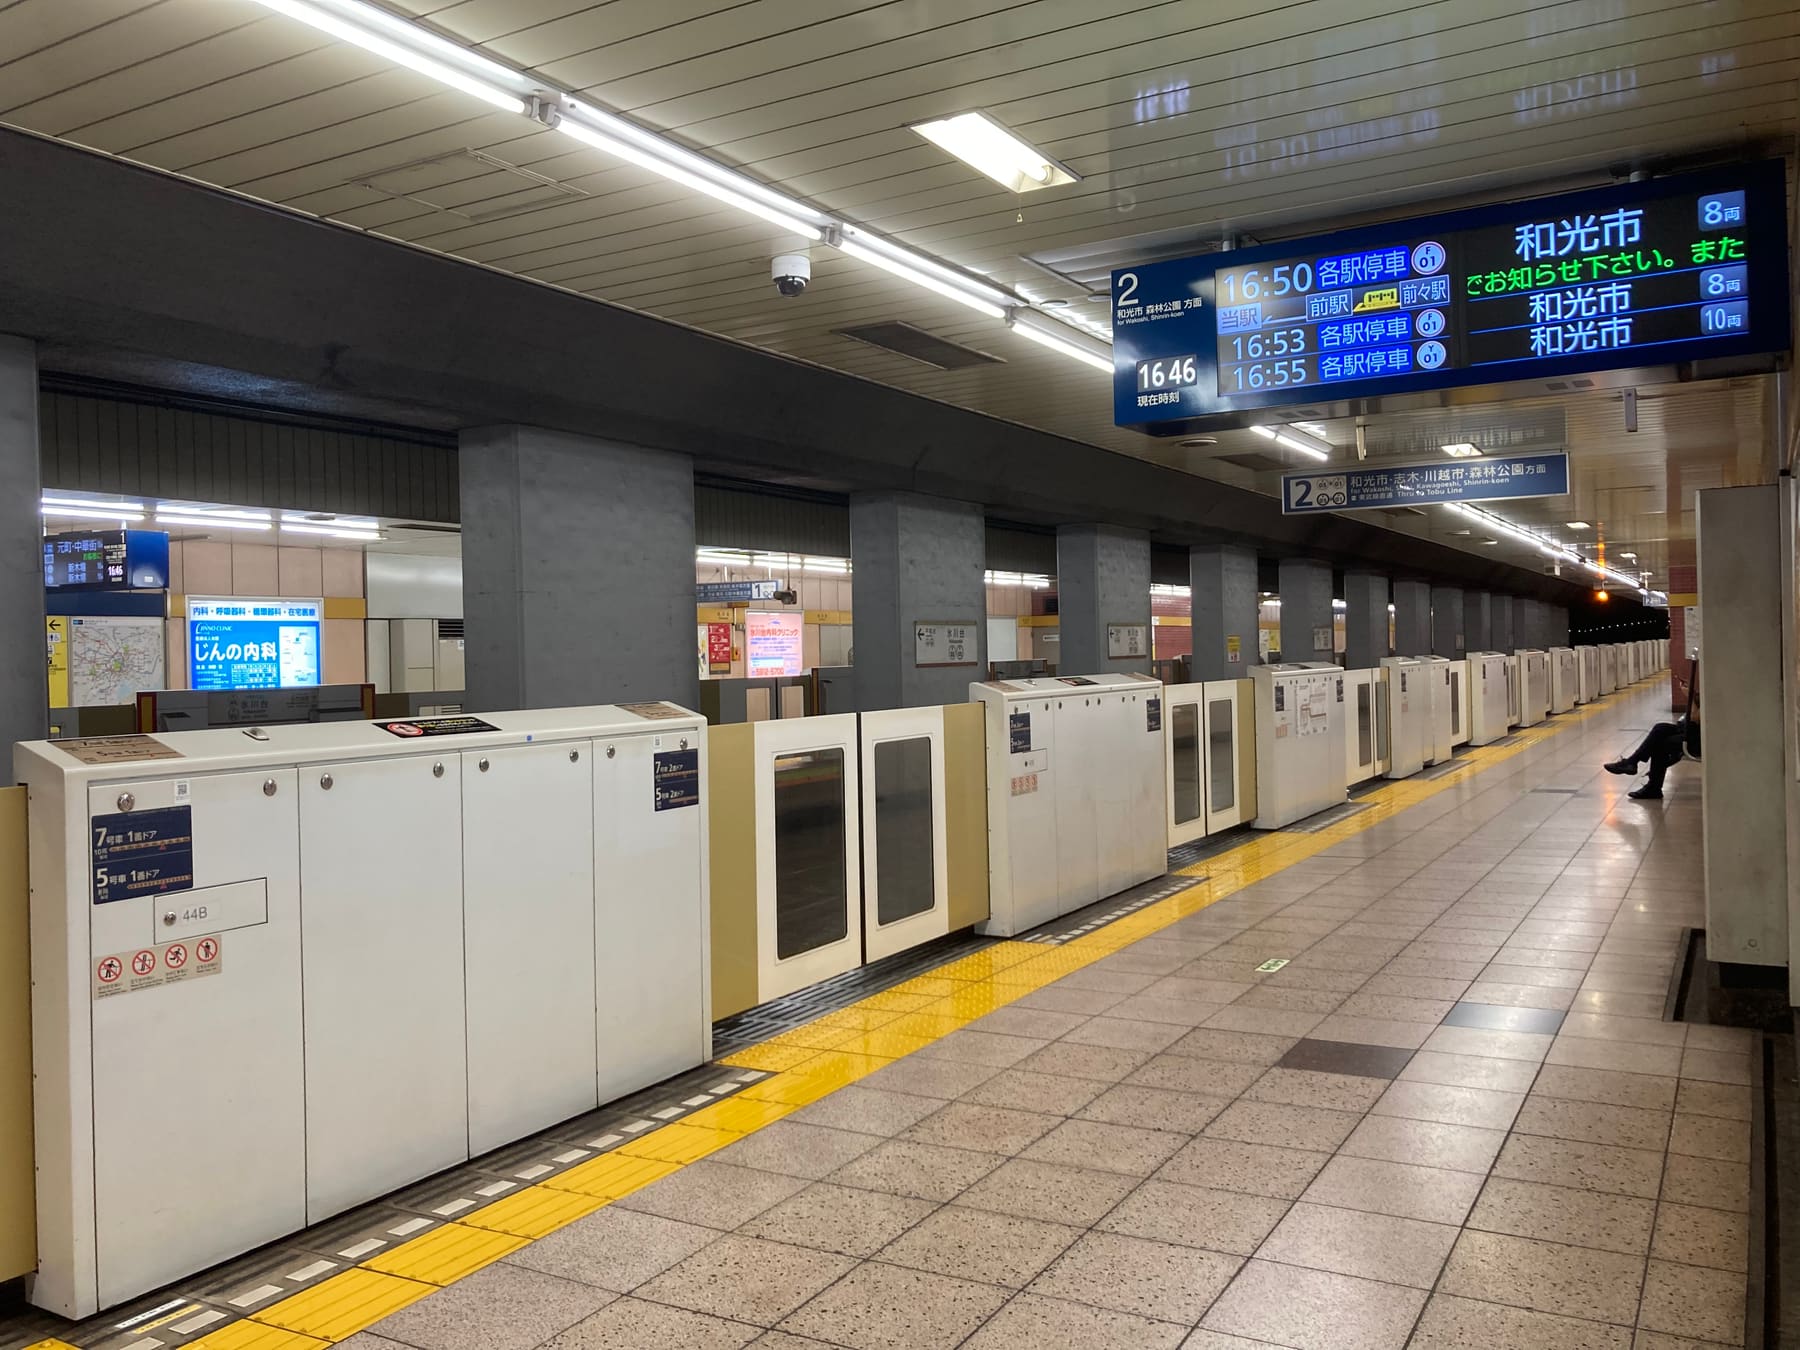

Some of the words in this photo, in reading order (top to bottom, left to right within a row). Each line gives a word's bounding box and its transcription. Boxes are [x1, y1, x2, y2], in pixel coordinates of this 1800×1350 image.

[1703, 200, 1741, 225] 8両
[1514, 208, 1643, 262] 和光市
[1419, 256, 1436, 268] 01
[1690, 236, 1745, 263] また
[1318, 250, 1407, 287] 各駅停車
[1117, 272, 1139, 307] 2
[1223, 262, 1313, 302] 16:50
[1402, 279, 1447, 305] 前々駅
[1707, 273, 1741, 295] 8両
[1117, 306, 1143, 319] 和光市
[1145, 300, 1182, 316] 森林公園
[1183, 297, 1202, 309] 方面
[1309, 292, 1350, 317] 前駅
[1528, 283, 1632, 323] 和光市
[1220, 308, 1258, 328] 当駅
[1422, 321, 1437, 332] 01
[1704, 307, 1742, 331] 10両
[1232, 328, 1306, 360] 16:53
[1320, 316, 1408, 347] 各駅停車
[1529, 317, 1633, 357] 和光市
[1322, 347, 1409, 379] 各駅停車
[1423, 353, 1438, 363] 01
[1233, 359, 1307, 390] 16:55
[1137, 390, 1180, 408] 現在時刻
[1294, 480, 1313, 507] 2
[195, 641, 277, 662] じんの内科
[182, 906, 208, 922] 44B
